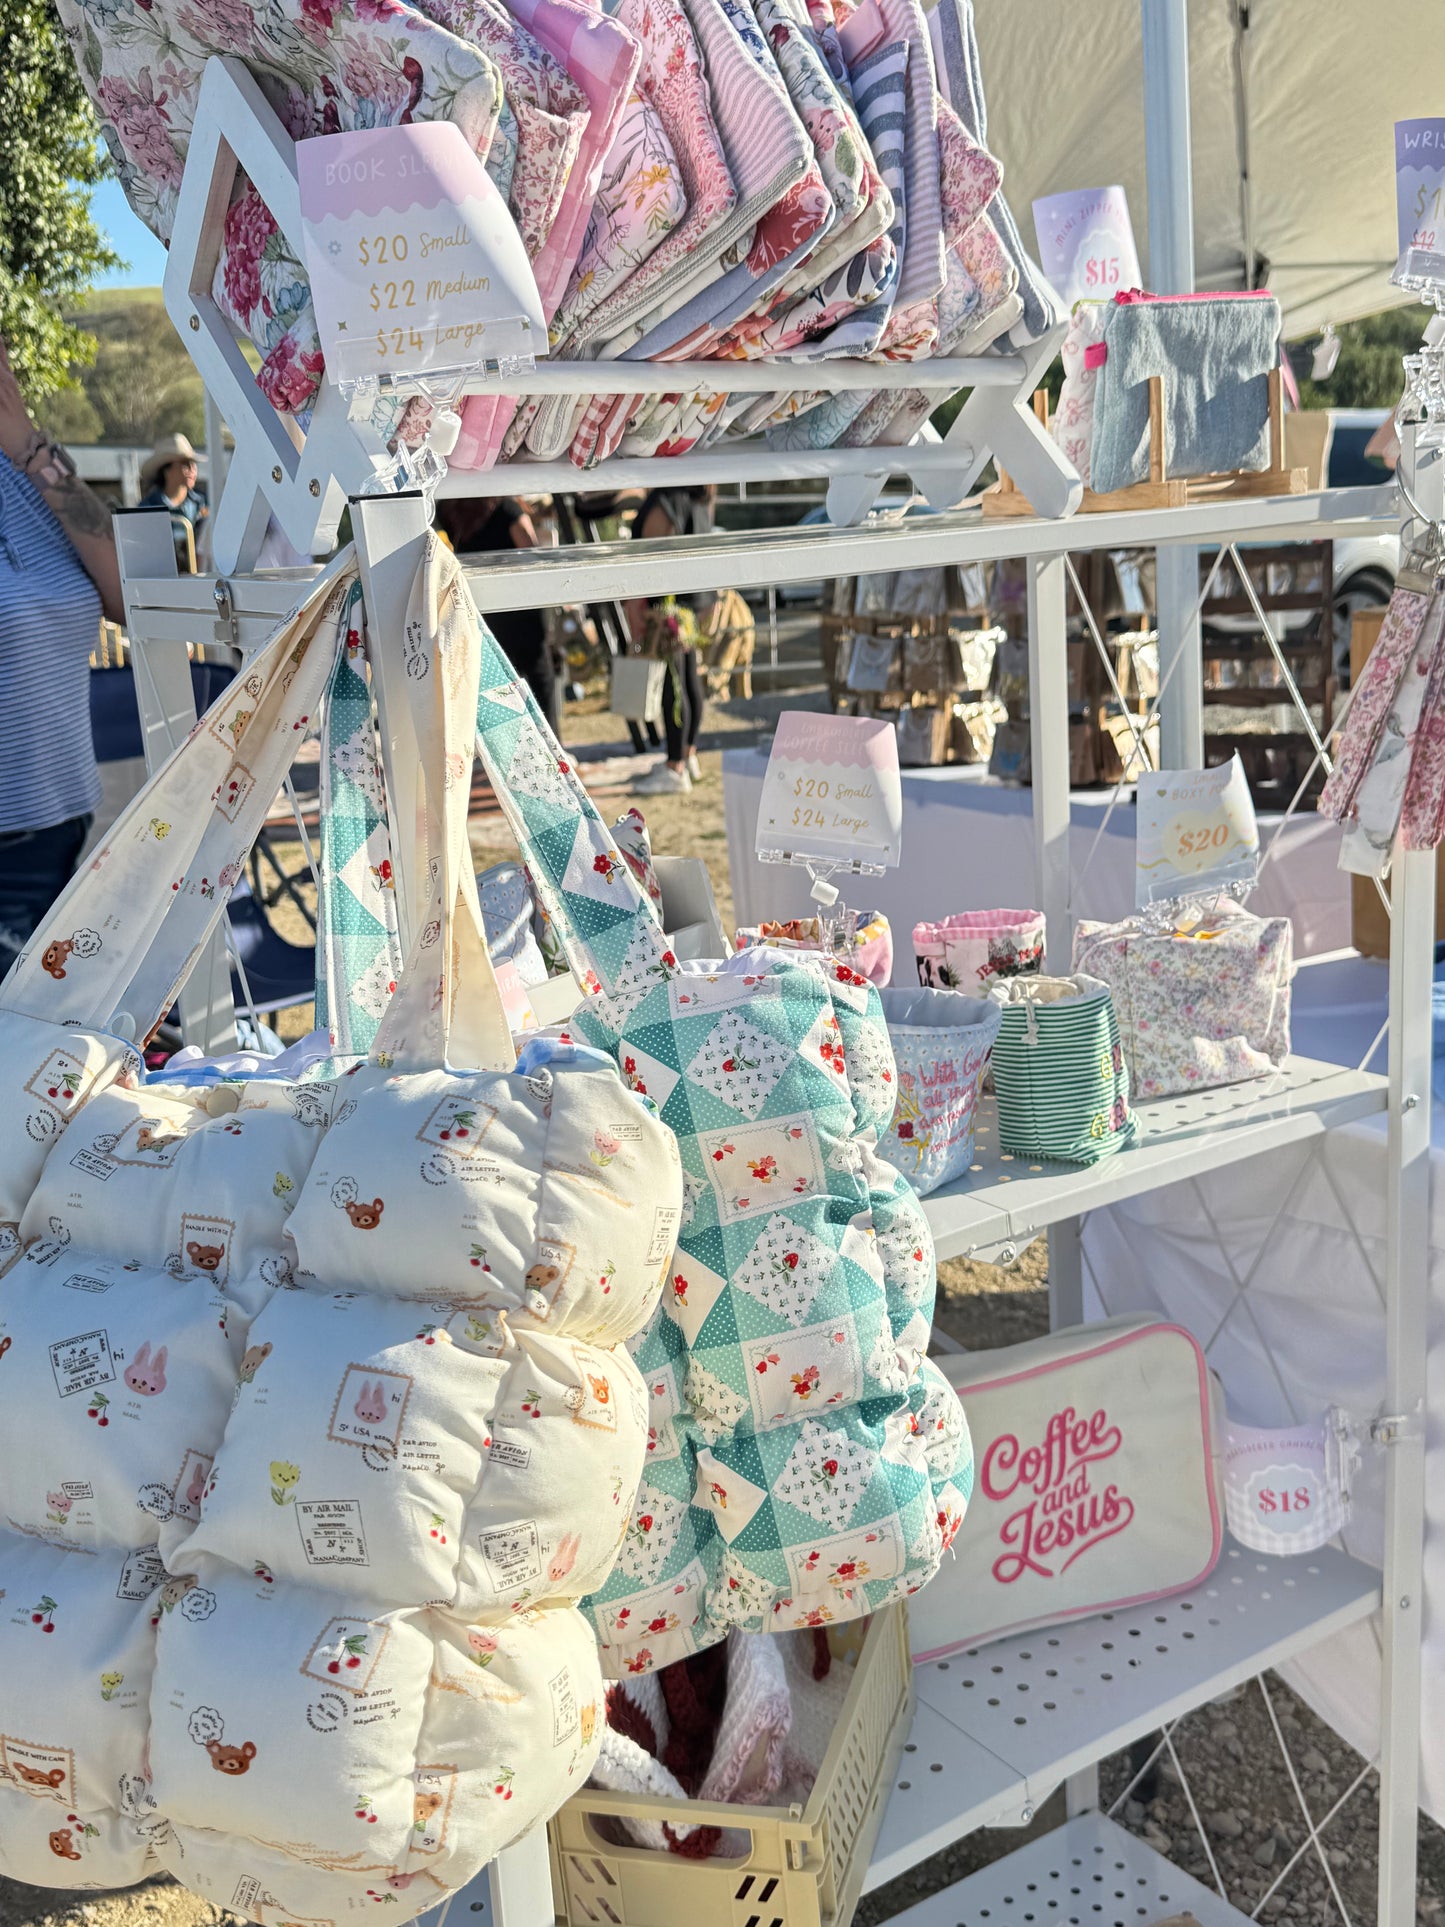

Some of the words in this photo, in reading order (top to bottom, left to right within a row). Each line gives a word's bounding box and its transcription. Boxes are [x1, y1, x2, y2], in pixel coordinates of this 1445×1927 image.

[325, 156, 387, 186] BOOK
[1414, 183, 1445, 220] $1
[358, 234, 409, 266] $20
[418, 223, 473, 258] Small
[1085, 256, 1120, 289] $15
[369, 279, 416, 312] $22
[375, 326, 424, 357] $24
[435, 322, 486, 349] Large
[793, 777, 830, 799] $20
[834, 783, 874, 801] Small
[792, 807, 826, 829] $24
[832, 813, 871, 834] Large
[1177, 823, 1230, 857] $20
[917, 1058, 958, 1089] With
[540, 1246, 563, 1263] USA
[391, 1393, 401, 1404] hi
[353, 1425, 371, 1438] USA
[980, 1405, 1123, 1501] Coffee
[1041, 1463, 1091, 1516] and
[1258, 1486, 1311, 1516] $18
[302, 1505, 313, 1514] BY
[317, 1504, 331, 1513] AIR
[332, 1503, 355, 1513] MAIL
[991, 1484, 1135, 1584] Jesus
[30, 1752, 47, 1761] WITH
[416, 1772, 443, 1786] USA
